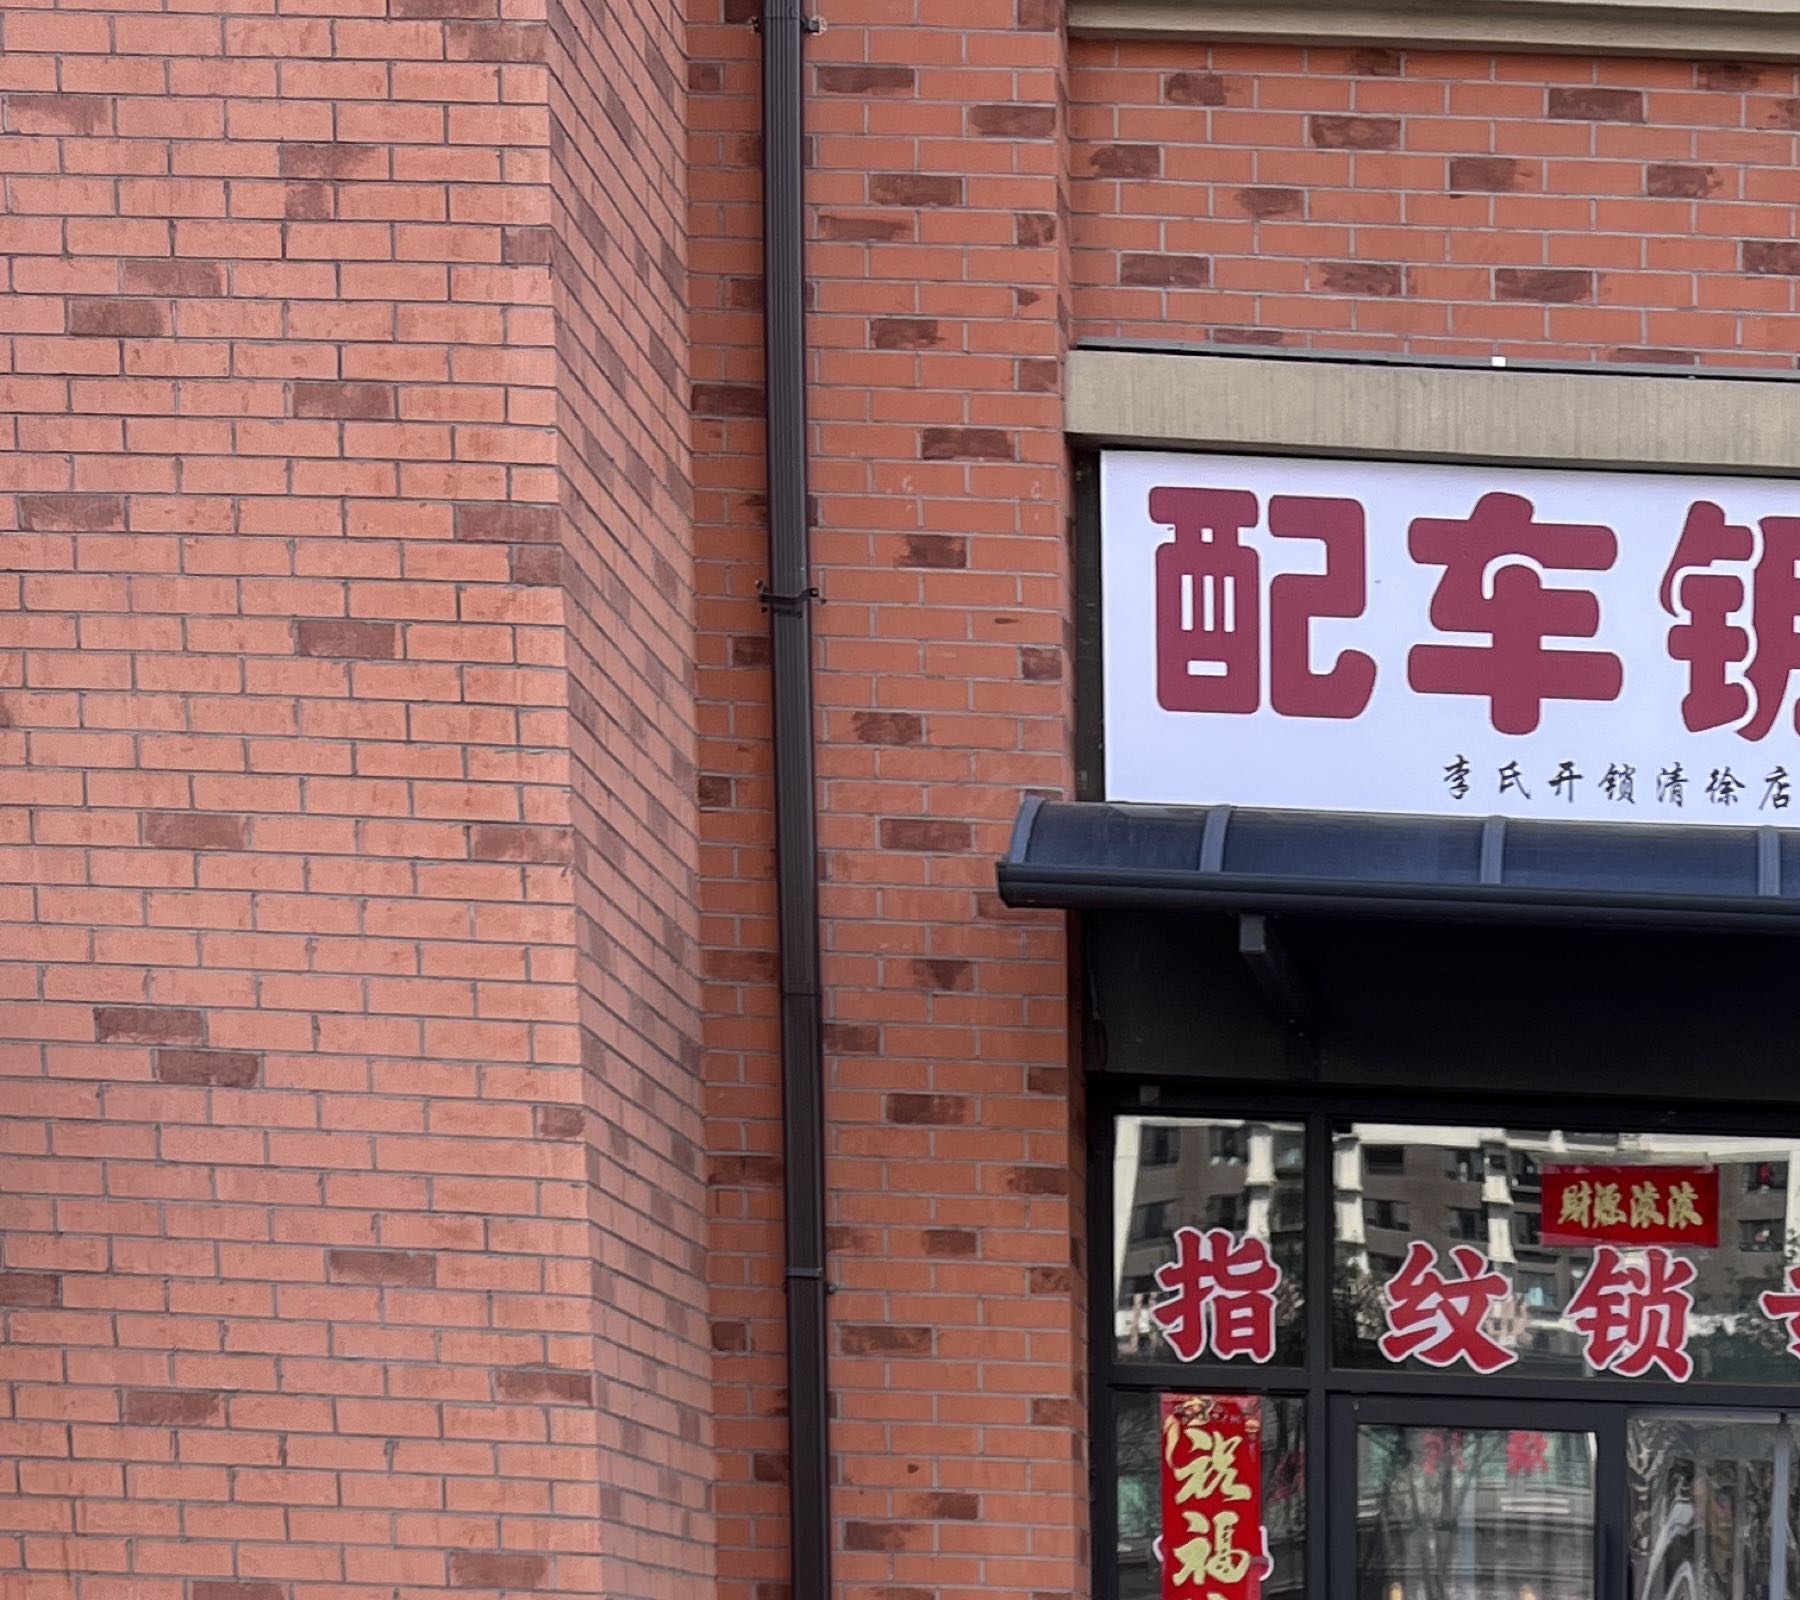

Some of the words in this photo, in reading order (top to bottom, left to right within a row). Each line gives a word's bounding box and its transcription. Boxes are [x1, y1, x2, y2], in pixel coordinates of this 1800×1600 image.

[1443, 753, 1793, 811] 李氏开锁清徐店
